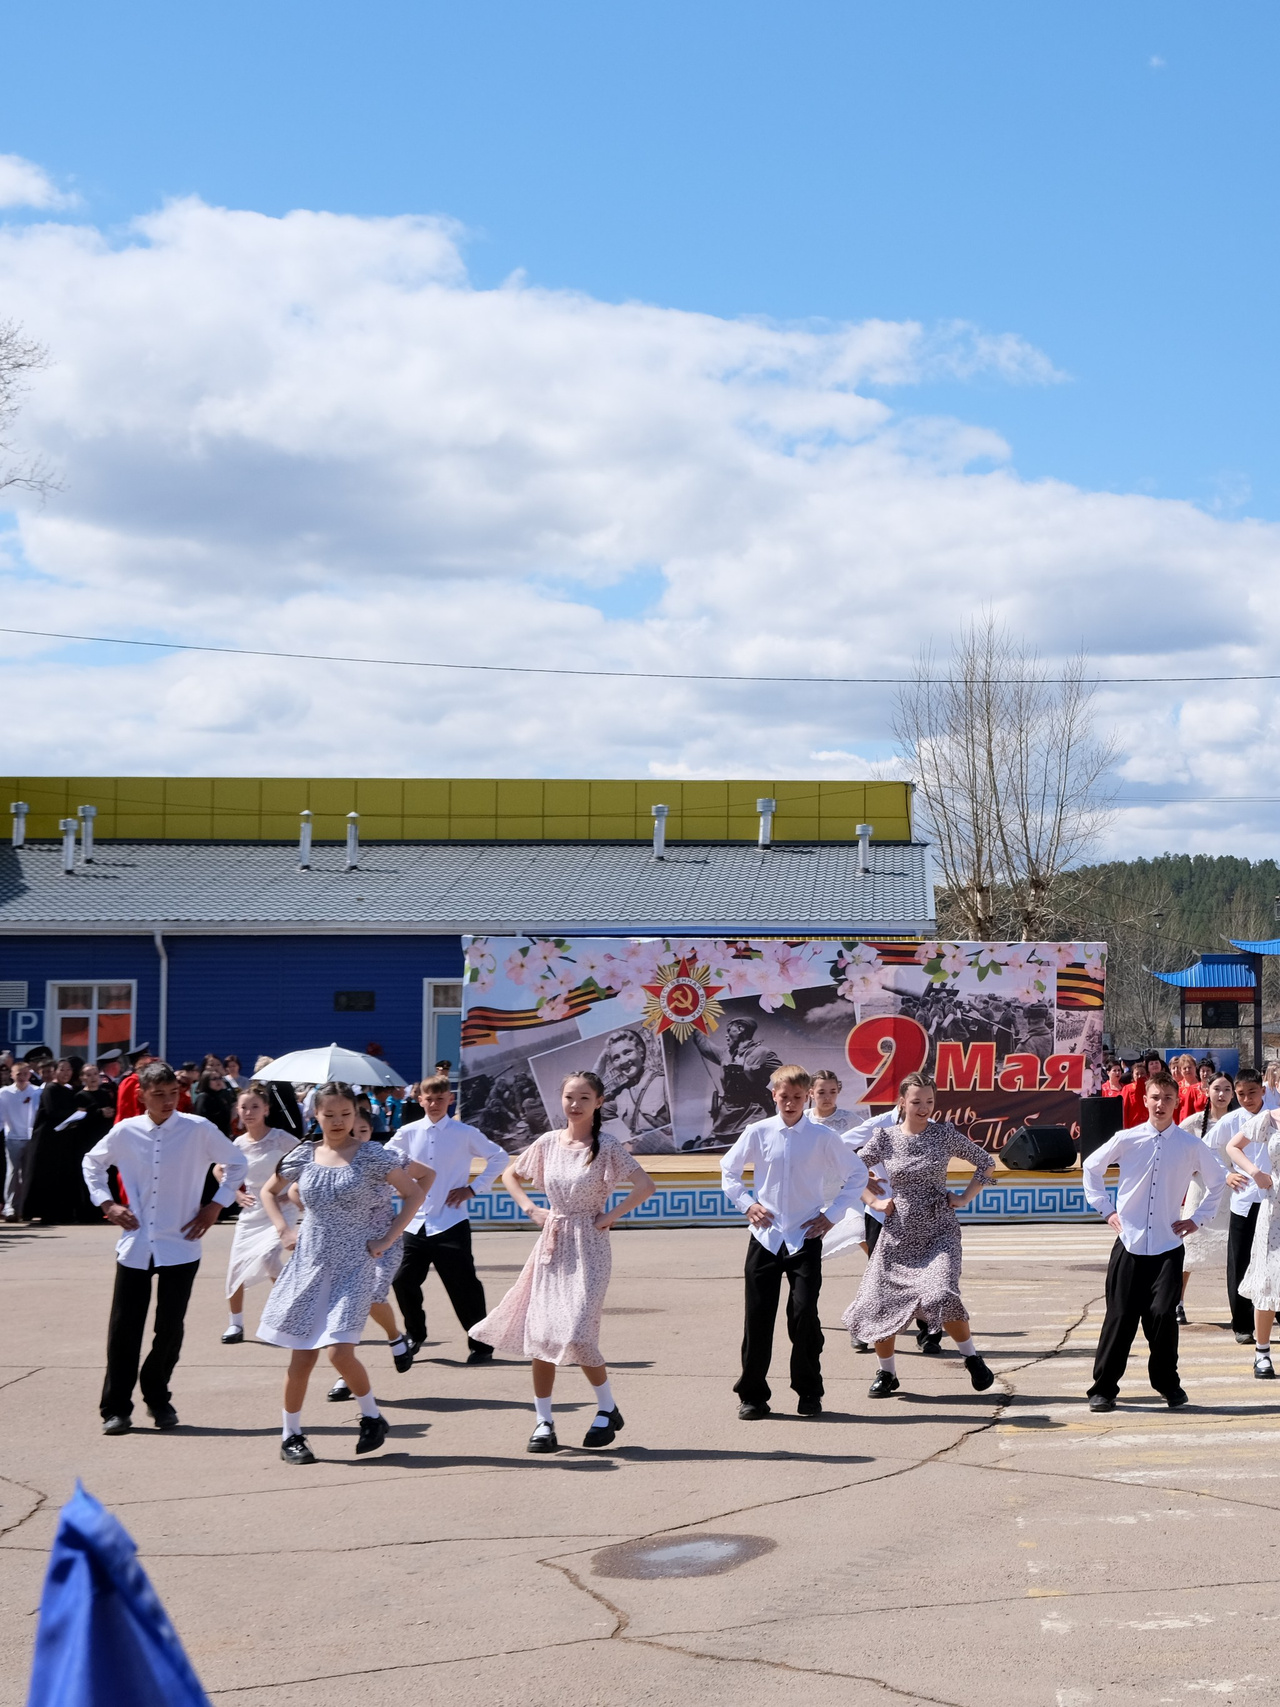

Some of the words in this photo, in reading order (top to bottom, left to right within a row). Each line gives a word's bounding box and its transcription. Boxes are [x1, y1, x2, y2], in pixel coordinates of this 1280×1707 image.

[16, 1012, 38, 1040] P
[845, 1014, 930, 1105] 9
[934, 1041, 1087, 1092] Мая
[931, 1106, 981, 1127] ень
